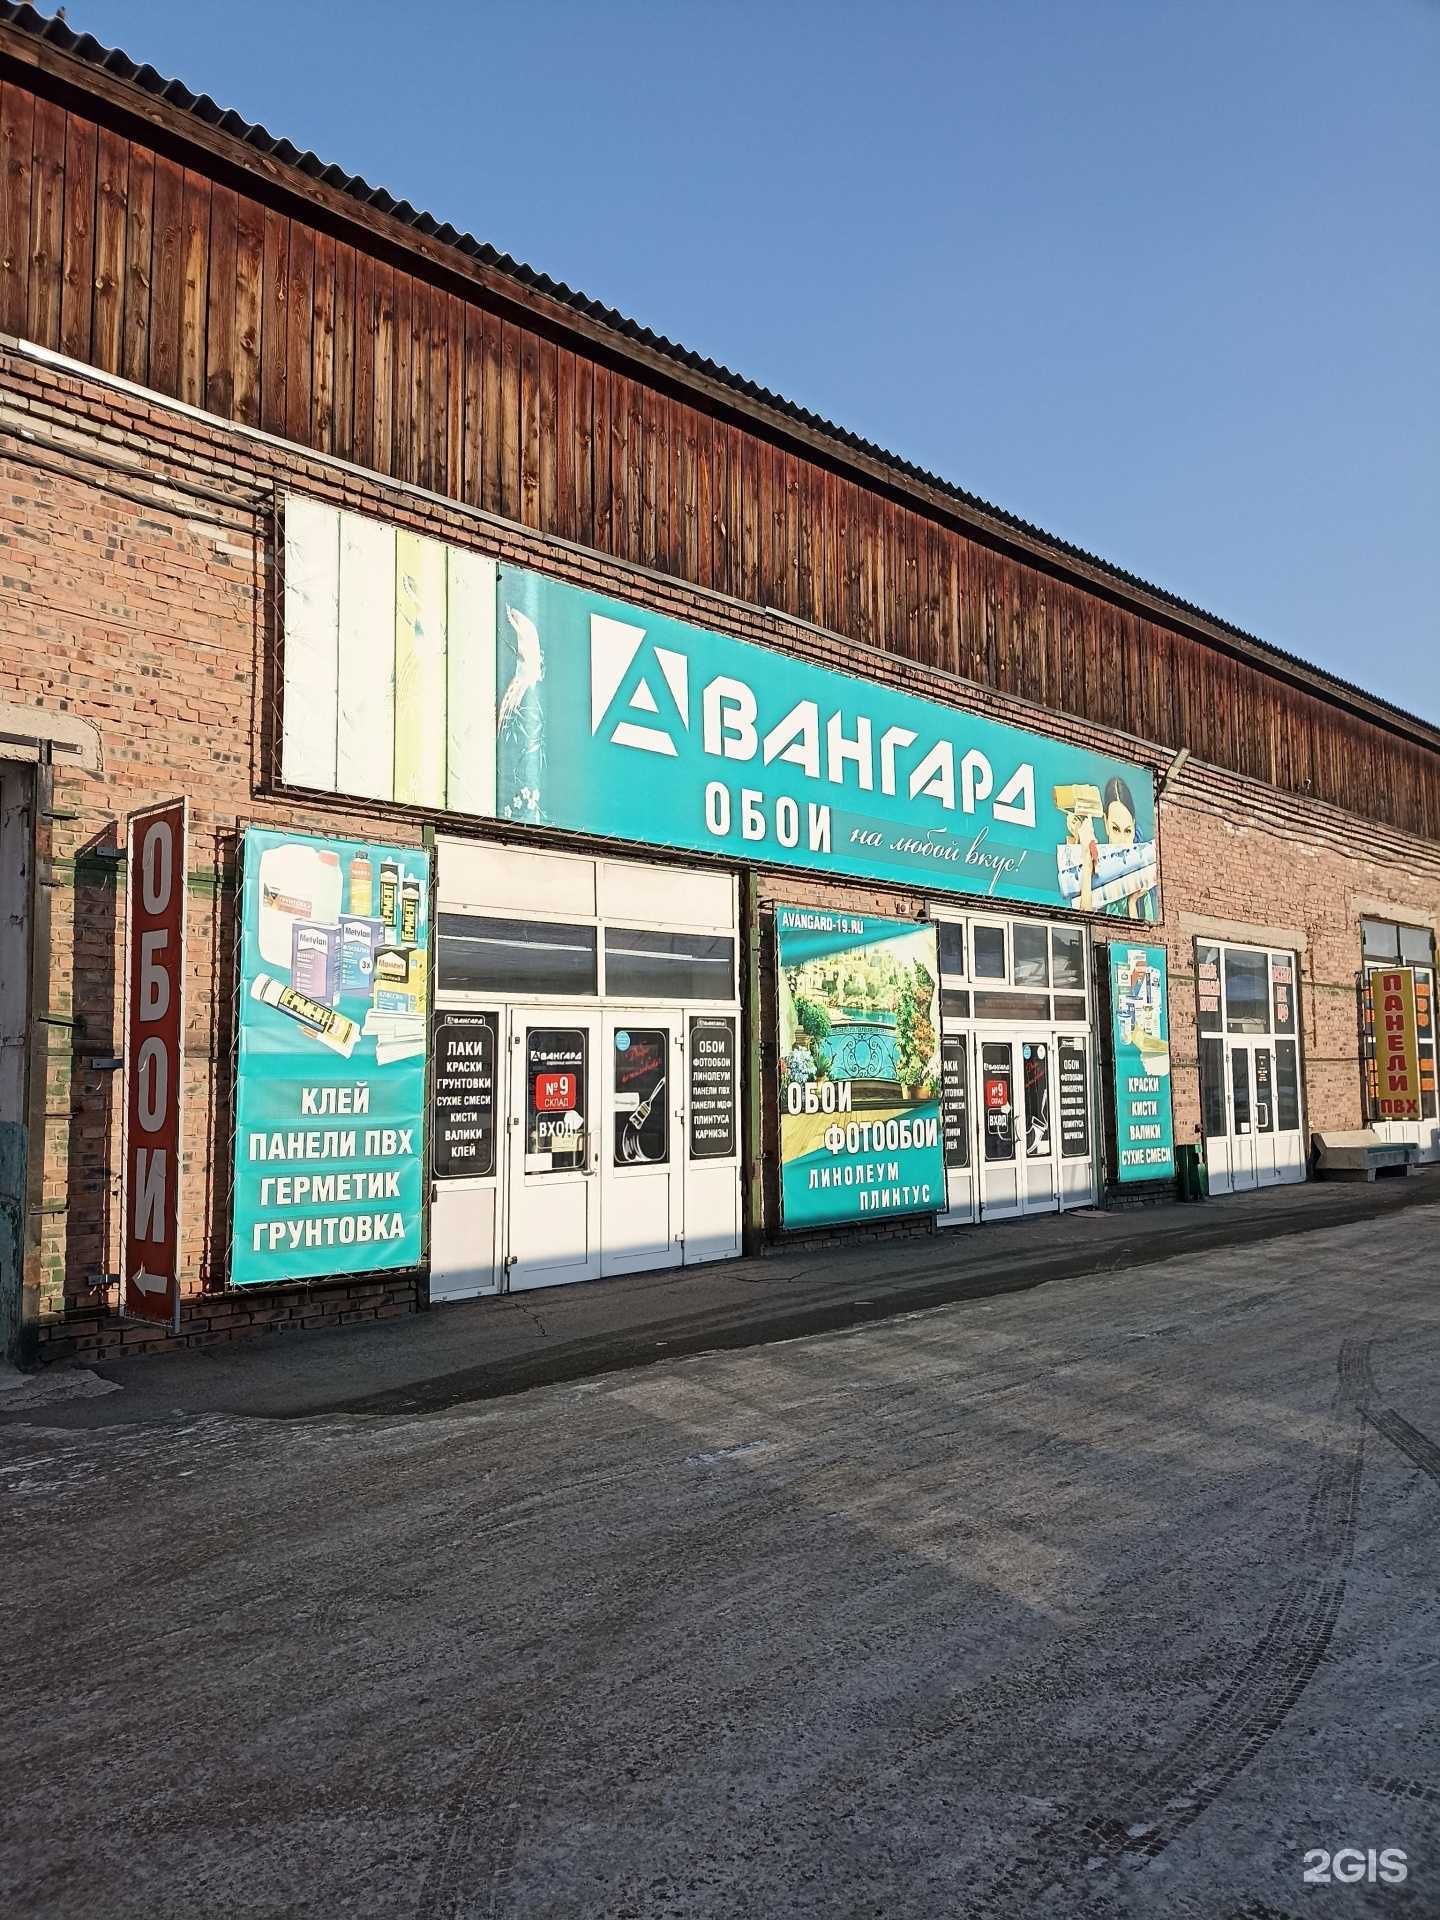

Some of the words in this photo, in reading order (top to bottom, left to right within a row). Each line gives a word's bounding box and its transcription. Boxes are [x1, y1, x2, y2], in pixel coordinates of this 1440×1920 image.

[590, 612, 1037, 828] АВАНГАРД
[705, 781, 831, 854] ОБОИ
[850, 828, 883, 847] на
[890, 826, 961, 861] любой
[965, 826, 1027, 895] вкус!
[782, 912, 864, 934] AVANGARD-19.RU
[135, 820, 173, 1243] ОБОИ
[1382, 975, 1408, 1092] ПАНЕЛИ
[447, 1042, 482, 1056] ЛАКИ
[699, 1041, 725, 1053] ОБОИ
[447, 1062, 482, 1072] КРАСКИ
[693, 1057, 731, 1067] ФОТООБОИ
[943, 1060, 958, 1072] АКИ
[437, 1078, 491, 1089] ГРУНТОВКИ
[693, 1072, 731, 1081] ЛИНОЛЕУМ
[1128, 1077, 1159, 1093] КРАСКИ
[301, 1080, 370, 1115] КЛЕЙ
[437, 1096, 462, 1106] СУХИЕ
[464, 1095, 490, 1105] СМЕСИ
[545, 1098, 568, 1108] СКЛАД
[787, 1081, 852, 1115] ОБОИ
[1131, 1100, 1157, 1116] КИСТИ
[1380, 1099, 1418, 1114] ПВХ
[450, 1112, 478, 1123] КИСТИ
[694, 1114, 730, 1125] ПЛИНТУСА
[445, 1129, 482, 1141] ВАЛИКИ
[695, 1128, 729, 1139] КАРНИЗЫ
[824, 1118, 938, 1155] ФОТООБОИ
[1129, 1124, 1161, 1141] ВАЛИКИ
[249, 1130, 356, 1162] ПАНЕЛИ
[365, 1127, 414, 1156] ПВХ
[451, 1144, 476, 1158] КЛЕЙ
[946, 1139, 958, 1150] ЛЕЙ
[1121, 1149, 1144, 1166] СУХИЕ
[1146, 1148, 1171, 1164] СМЕСИ
[809, 1161, 899, 1189] ЛИНОЛЕУМ
[260, 1170, 401, 1206] ГЕРМЕТИК
[860, 1184, 930, 1211] ПЛИНТУС
[252, 1212, 405, 1252] ГРУНТОВКА
